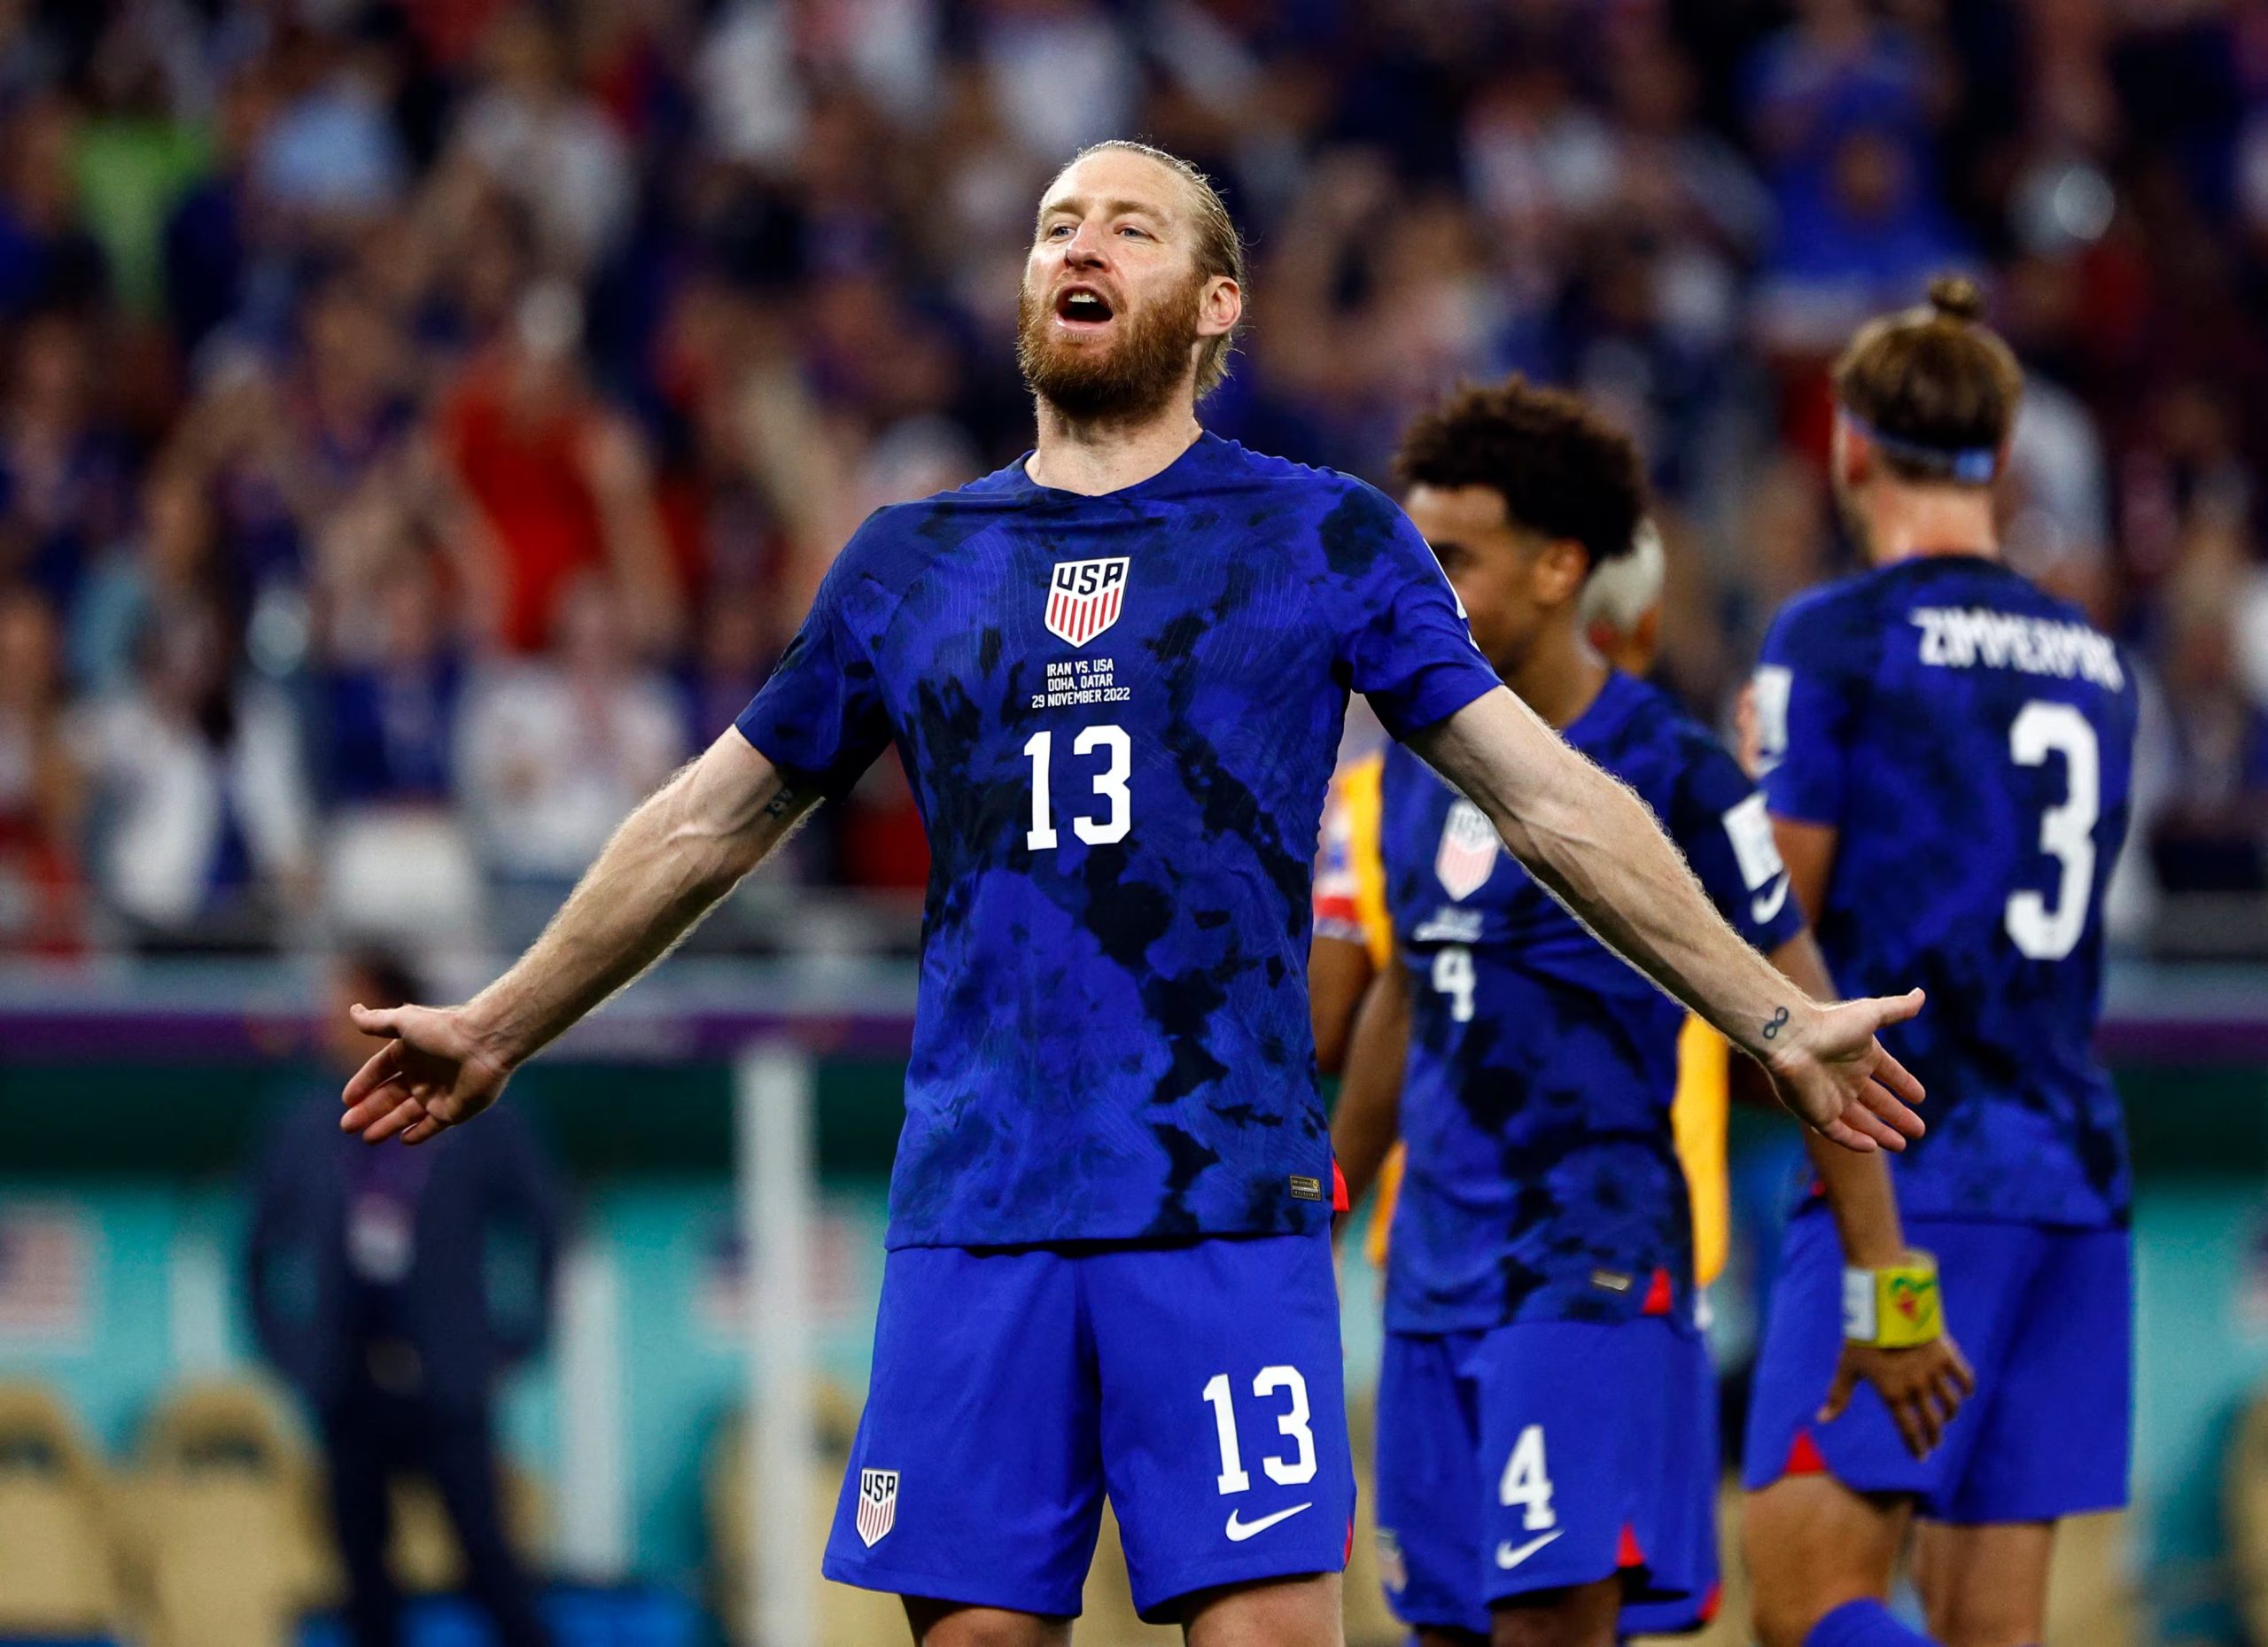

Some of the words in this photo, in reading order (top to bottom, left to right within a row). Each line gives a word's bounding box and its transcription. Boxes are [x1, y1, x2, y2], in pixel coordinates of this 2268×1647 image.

[1057, 563, 1124, 595] USA
[1047, 663, 1072, 677] IRAN
[1075, 661, 1091, 674] VS.
[1093, 658, 1114, 672] USA
[1047, 677, 1077, 692] DOHA,
[1081, 673, 1114, 688] QATAR
[1032, 695, 1045, 709] 29
[1047, 689, 1102, 707] NOVEMBER
[1103, 687, 1130, 702] 2022
[1023, 725, 1131, 851] 13
[2006, 699, 2101, 961] 3
[1202, 1364, 1318, 1496] 13
[863, 1473, 896, 1503] USA
[1499, 1424, 1557, 1532] 4
